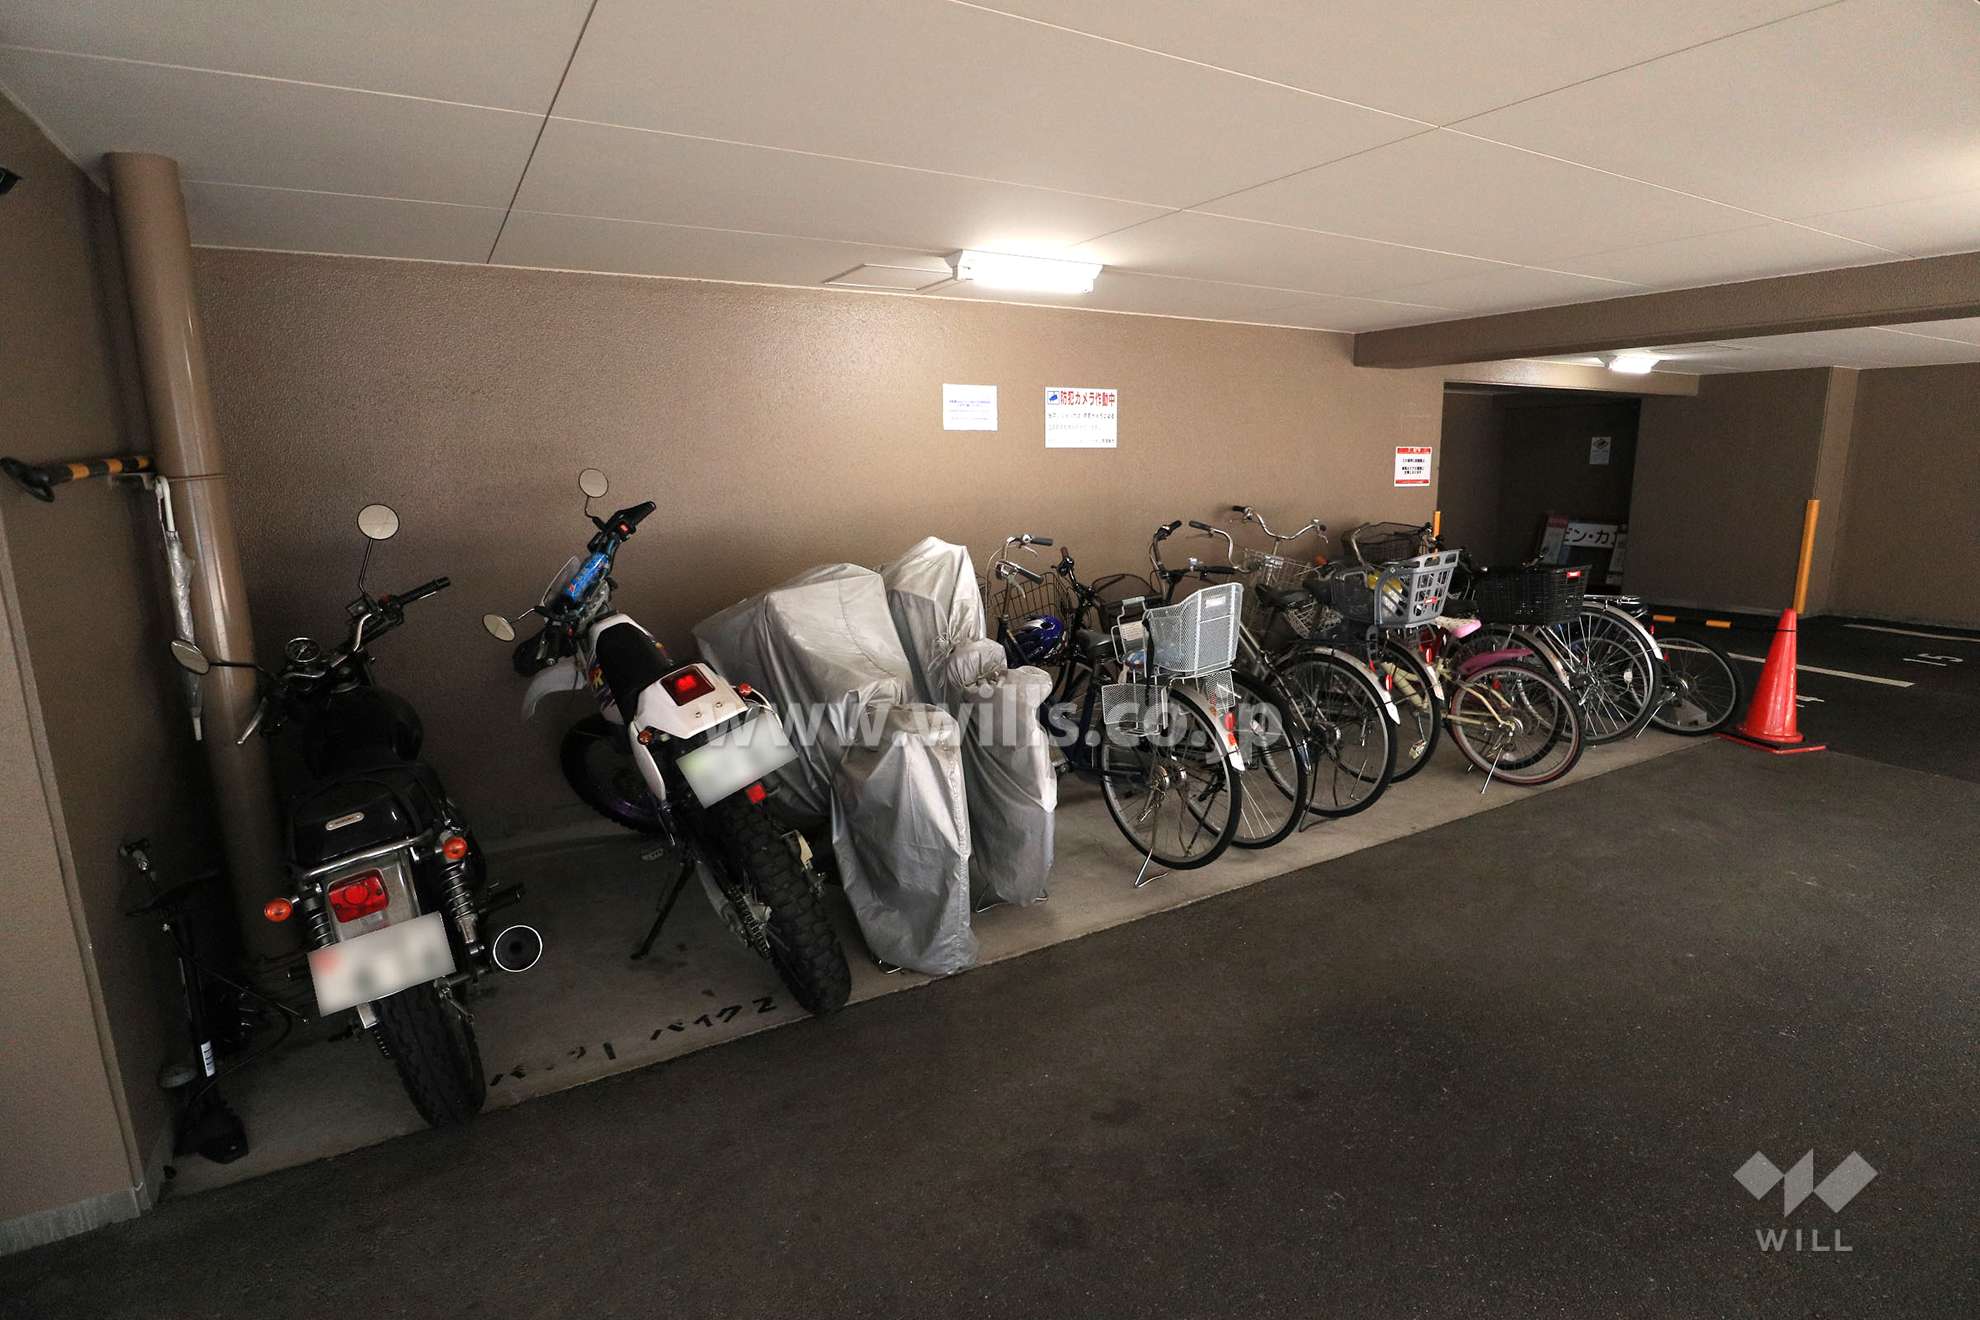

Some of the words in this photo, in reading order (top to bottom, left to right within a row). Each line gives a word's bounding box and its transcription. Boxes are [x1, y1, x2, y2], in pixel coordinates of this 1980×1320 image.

[1060, 389, 1116, 408] 防犯カメラ作動中
